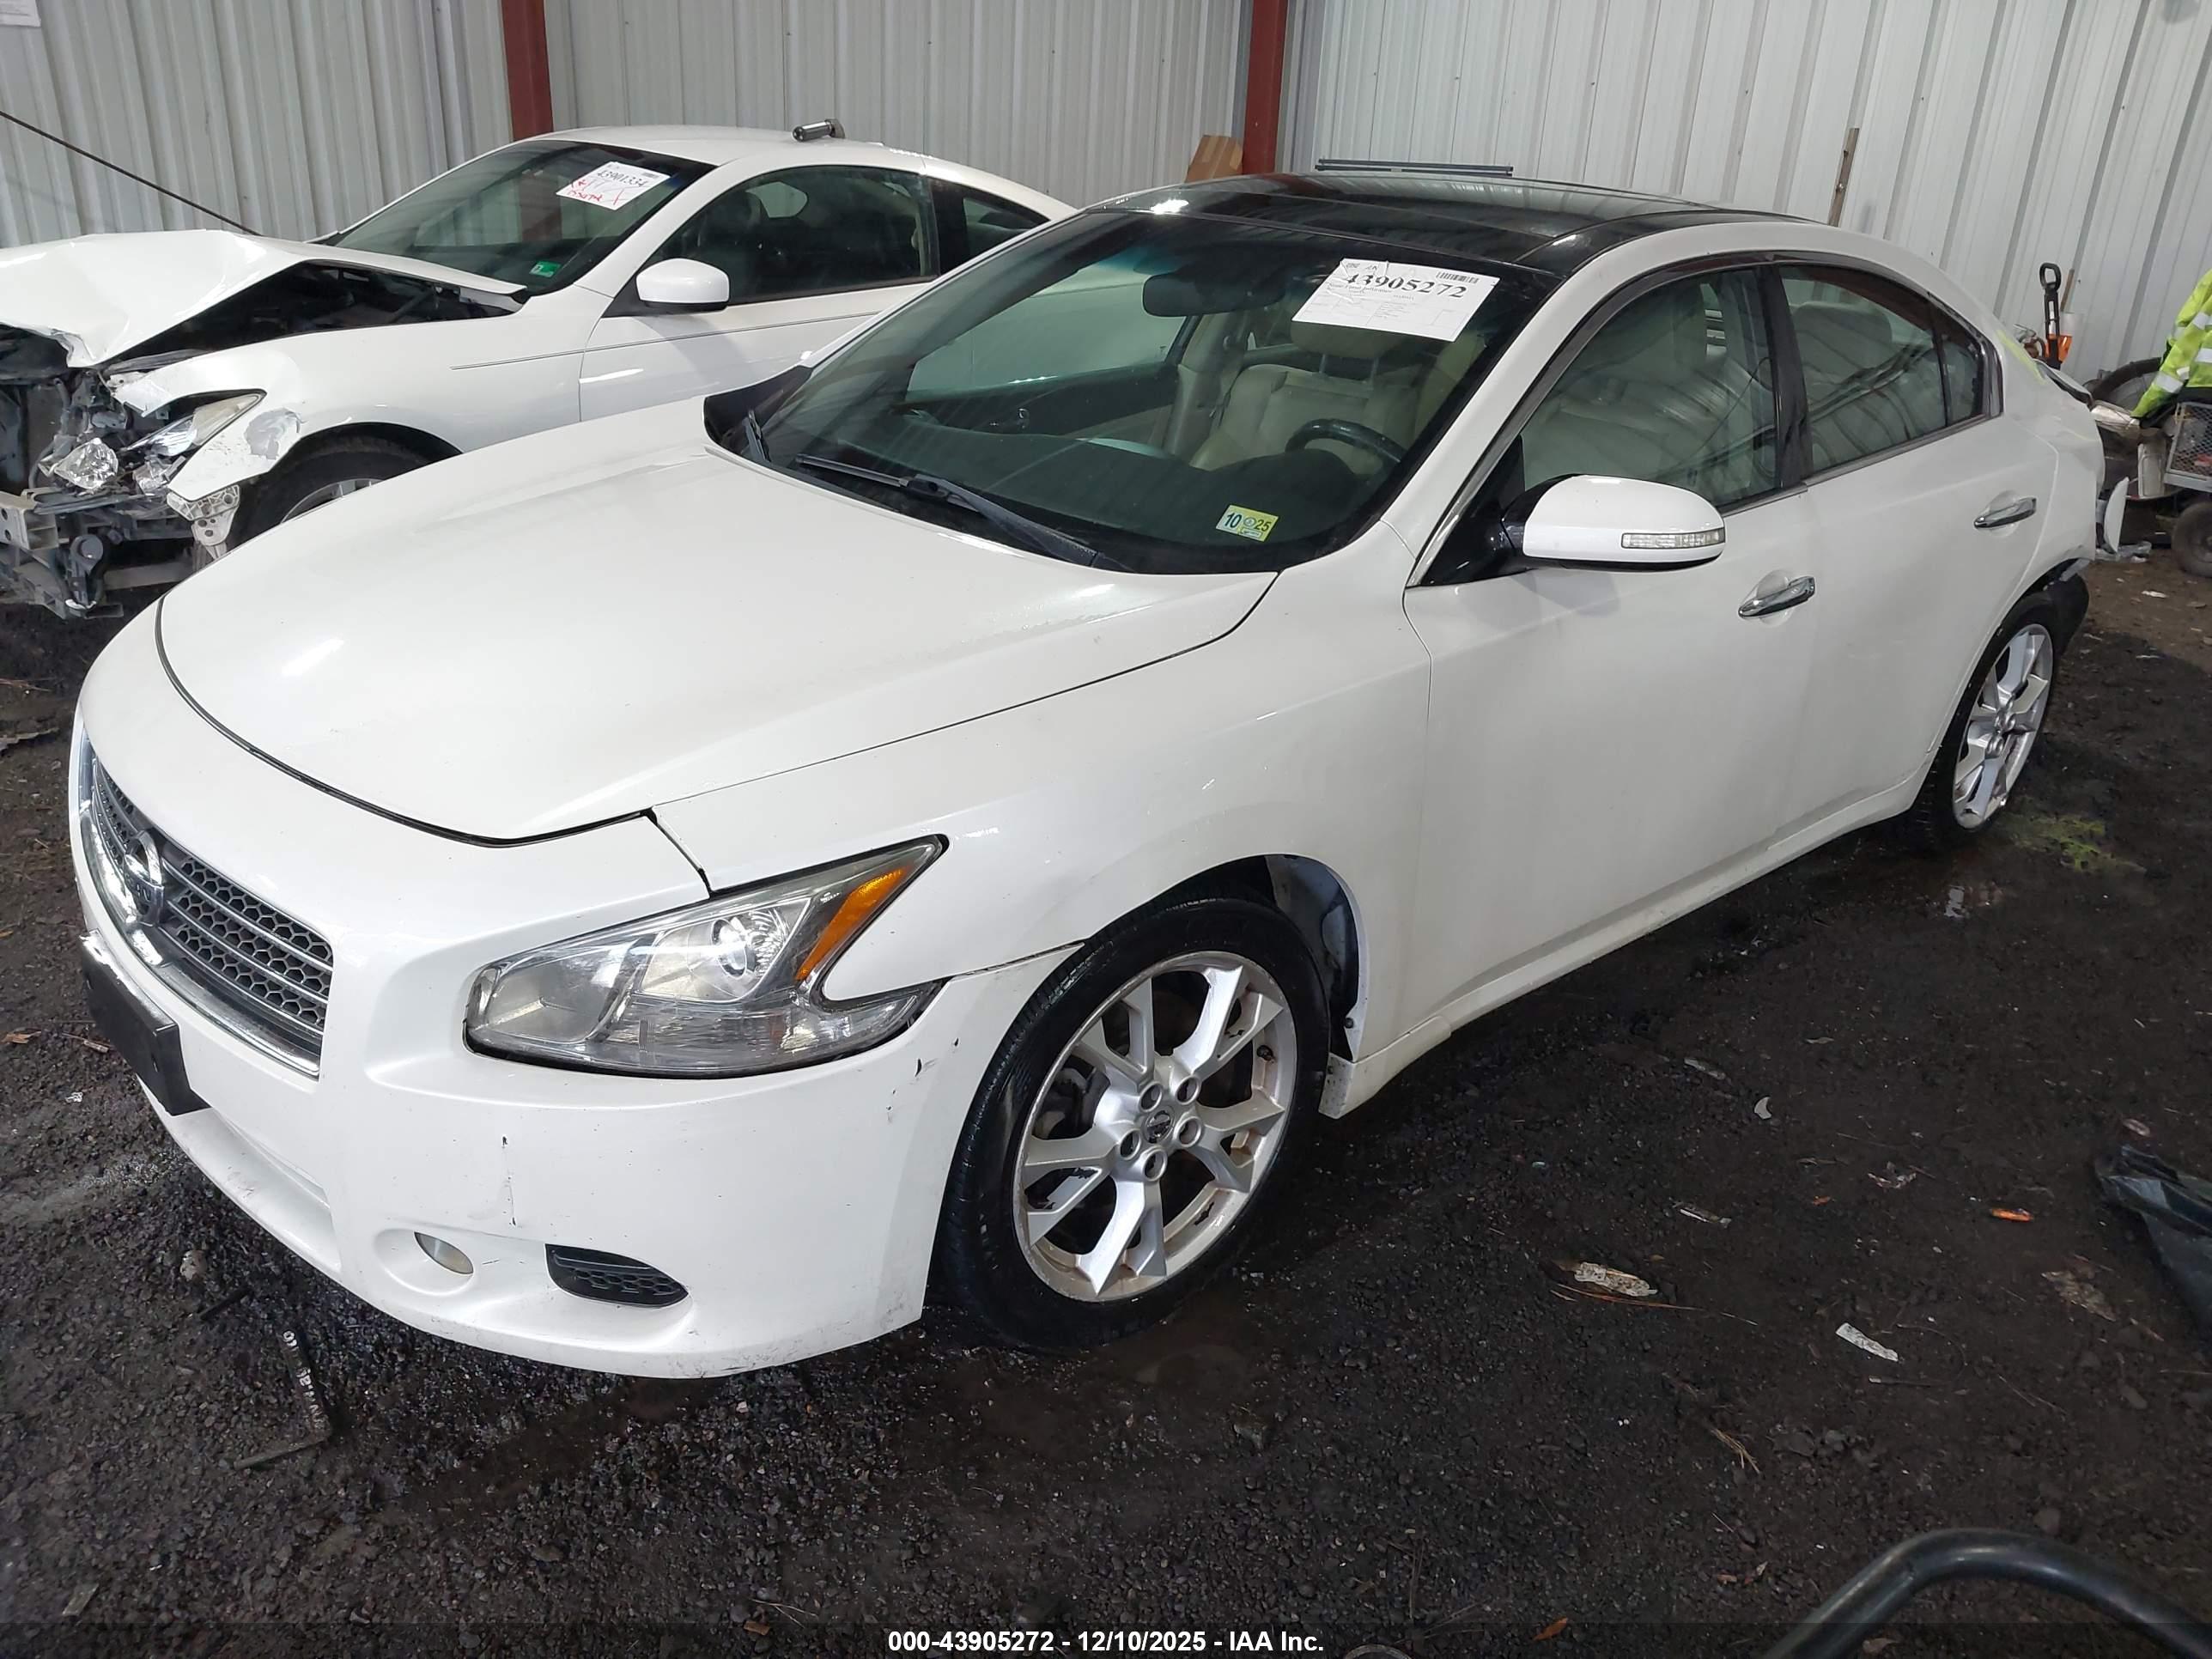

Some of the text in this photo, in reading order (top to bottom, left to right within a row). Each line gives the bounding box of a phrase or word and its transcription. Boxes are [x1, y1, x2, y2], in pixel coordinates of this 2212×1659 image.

[1345, 273, 1468, 299] 43905272
[1224, 512, 1273, 532] 10 25
